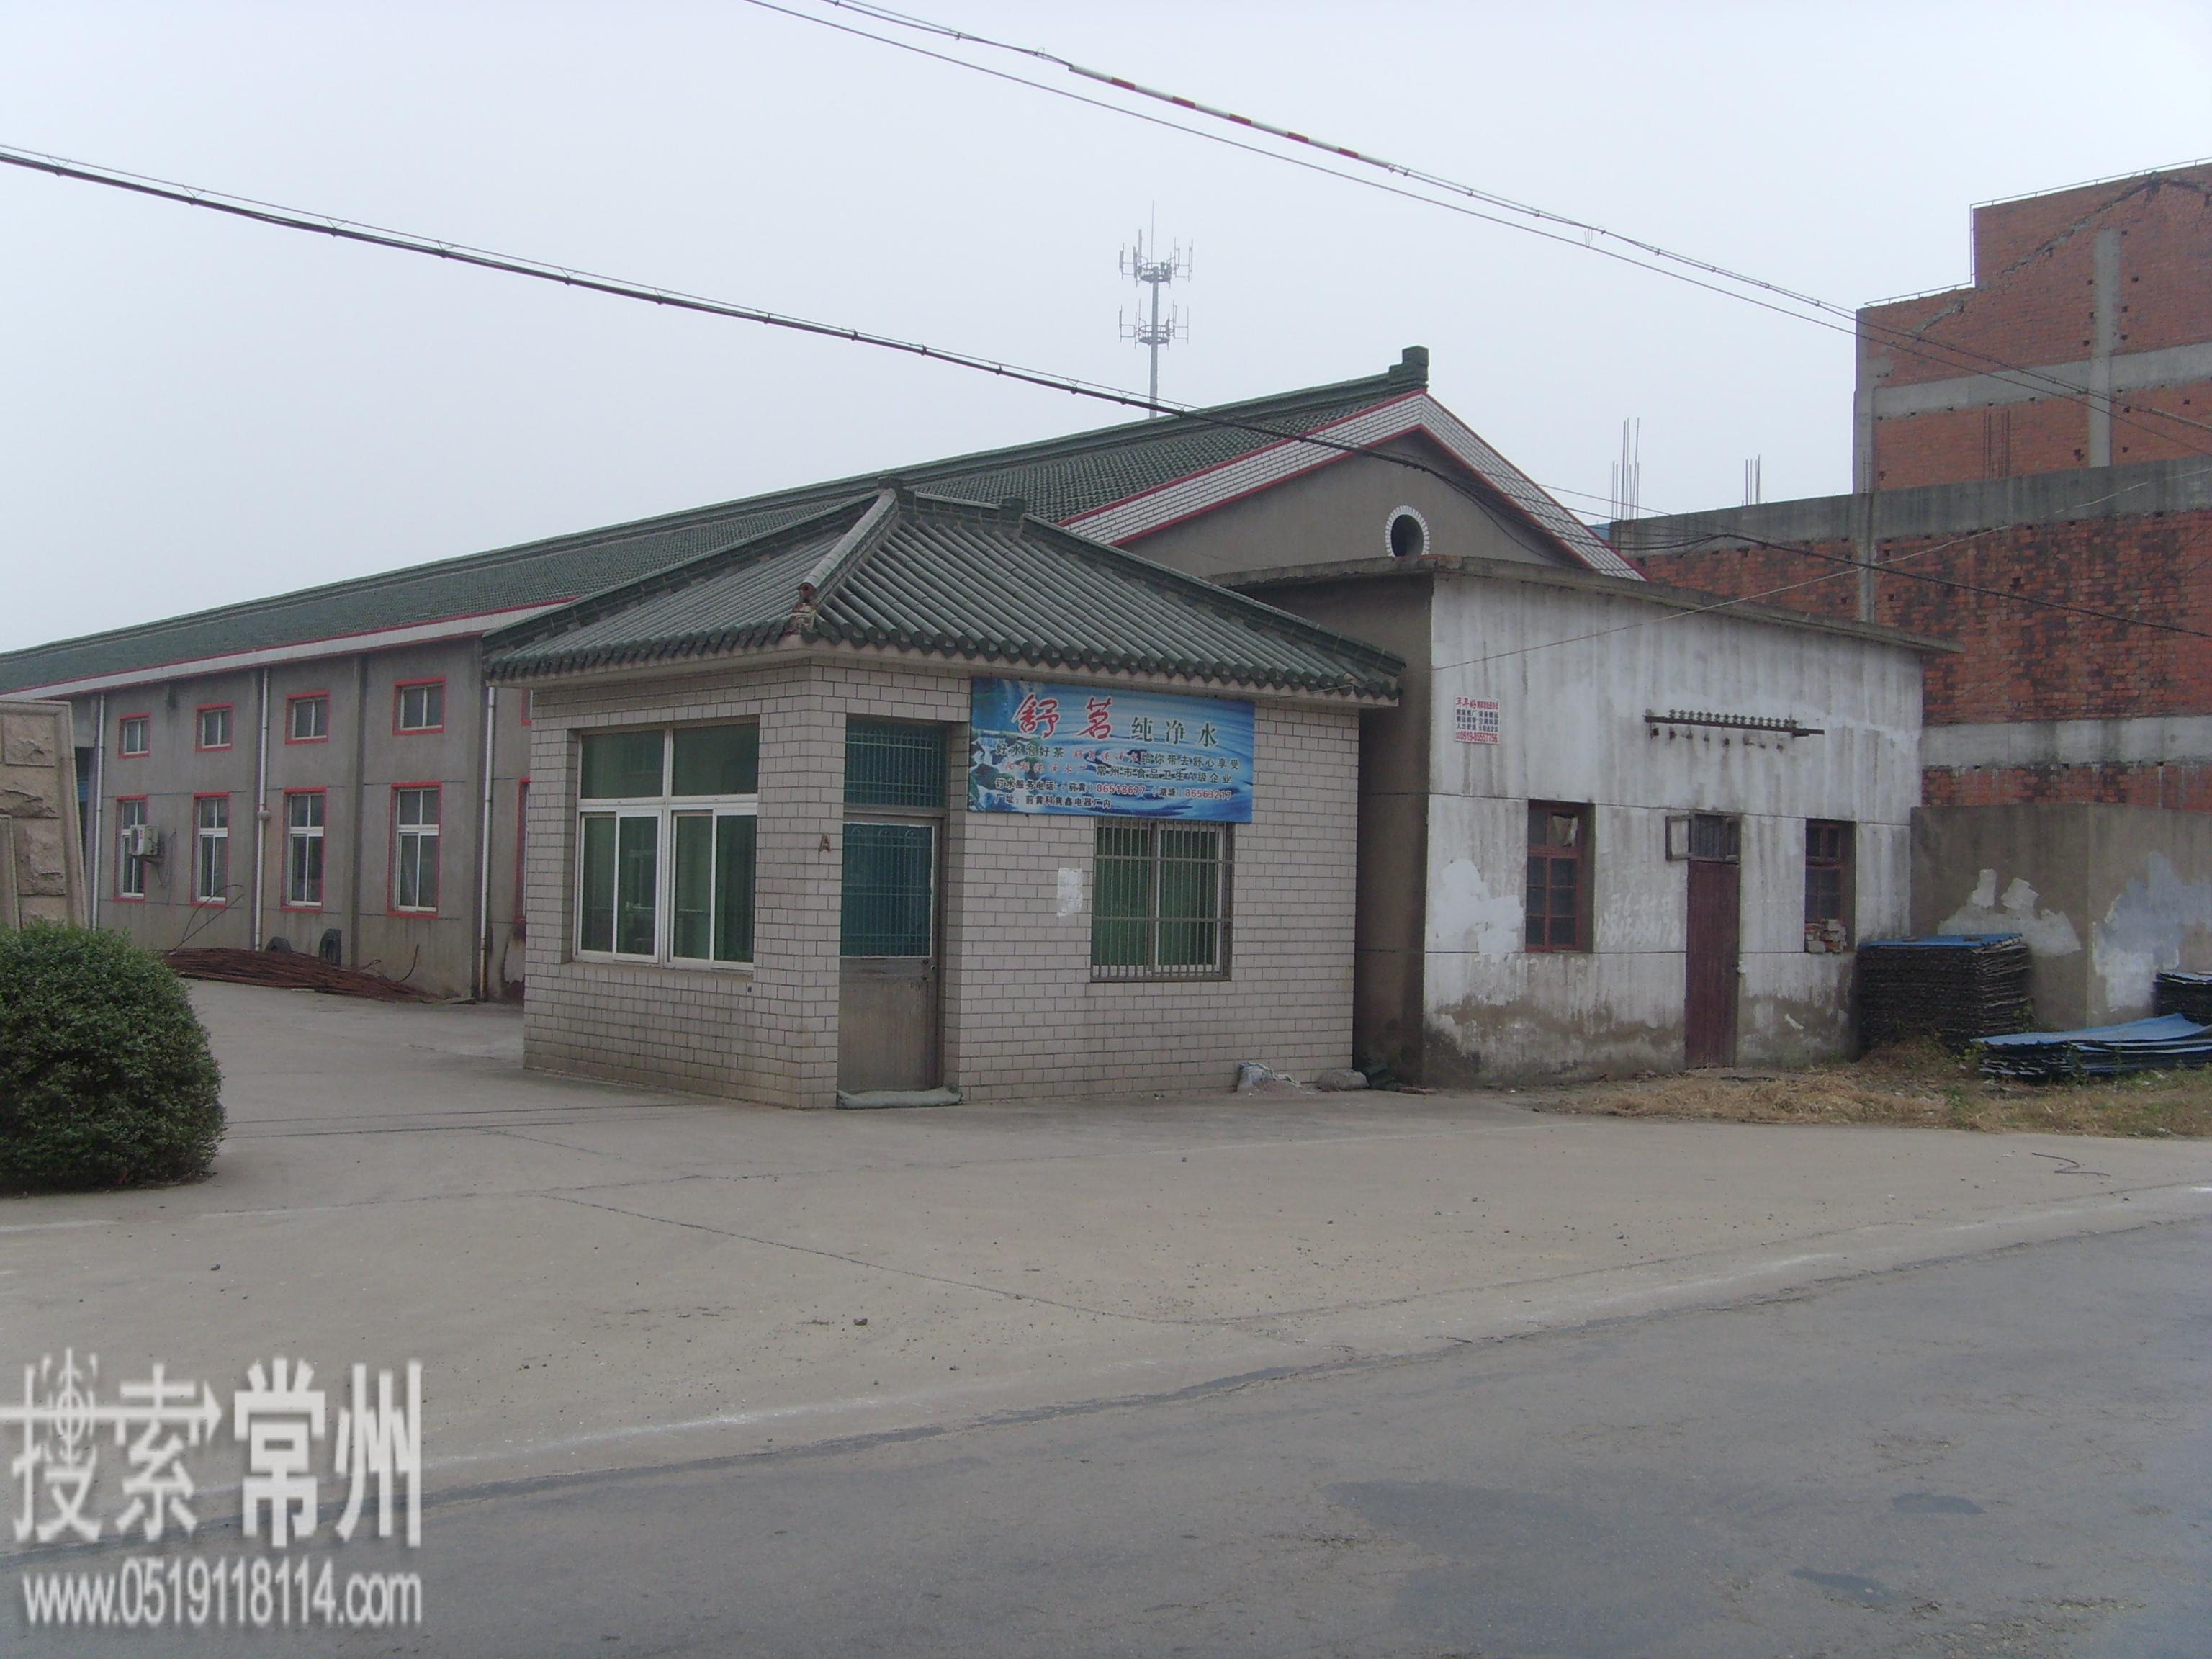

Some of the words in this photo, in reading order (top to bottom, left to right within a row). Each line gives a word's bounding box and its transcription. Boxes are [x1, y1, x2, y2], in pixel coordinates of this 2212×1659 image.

[1130, 716, 1218, 748] 纯净水
[995, 743, 1065, 758] 好水泡好茶
